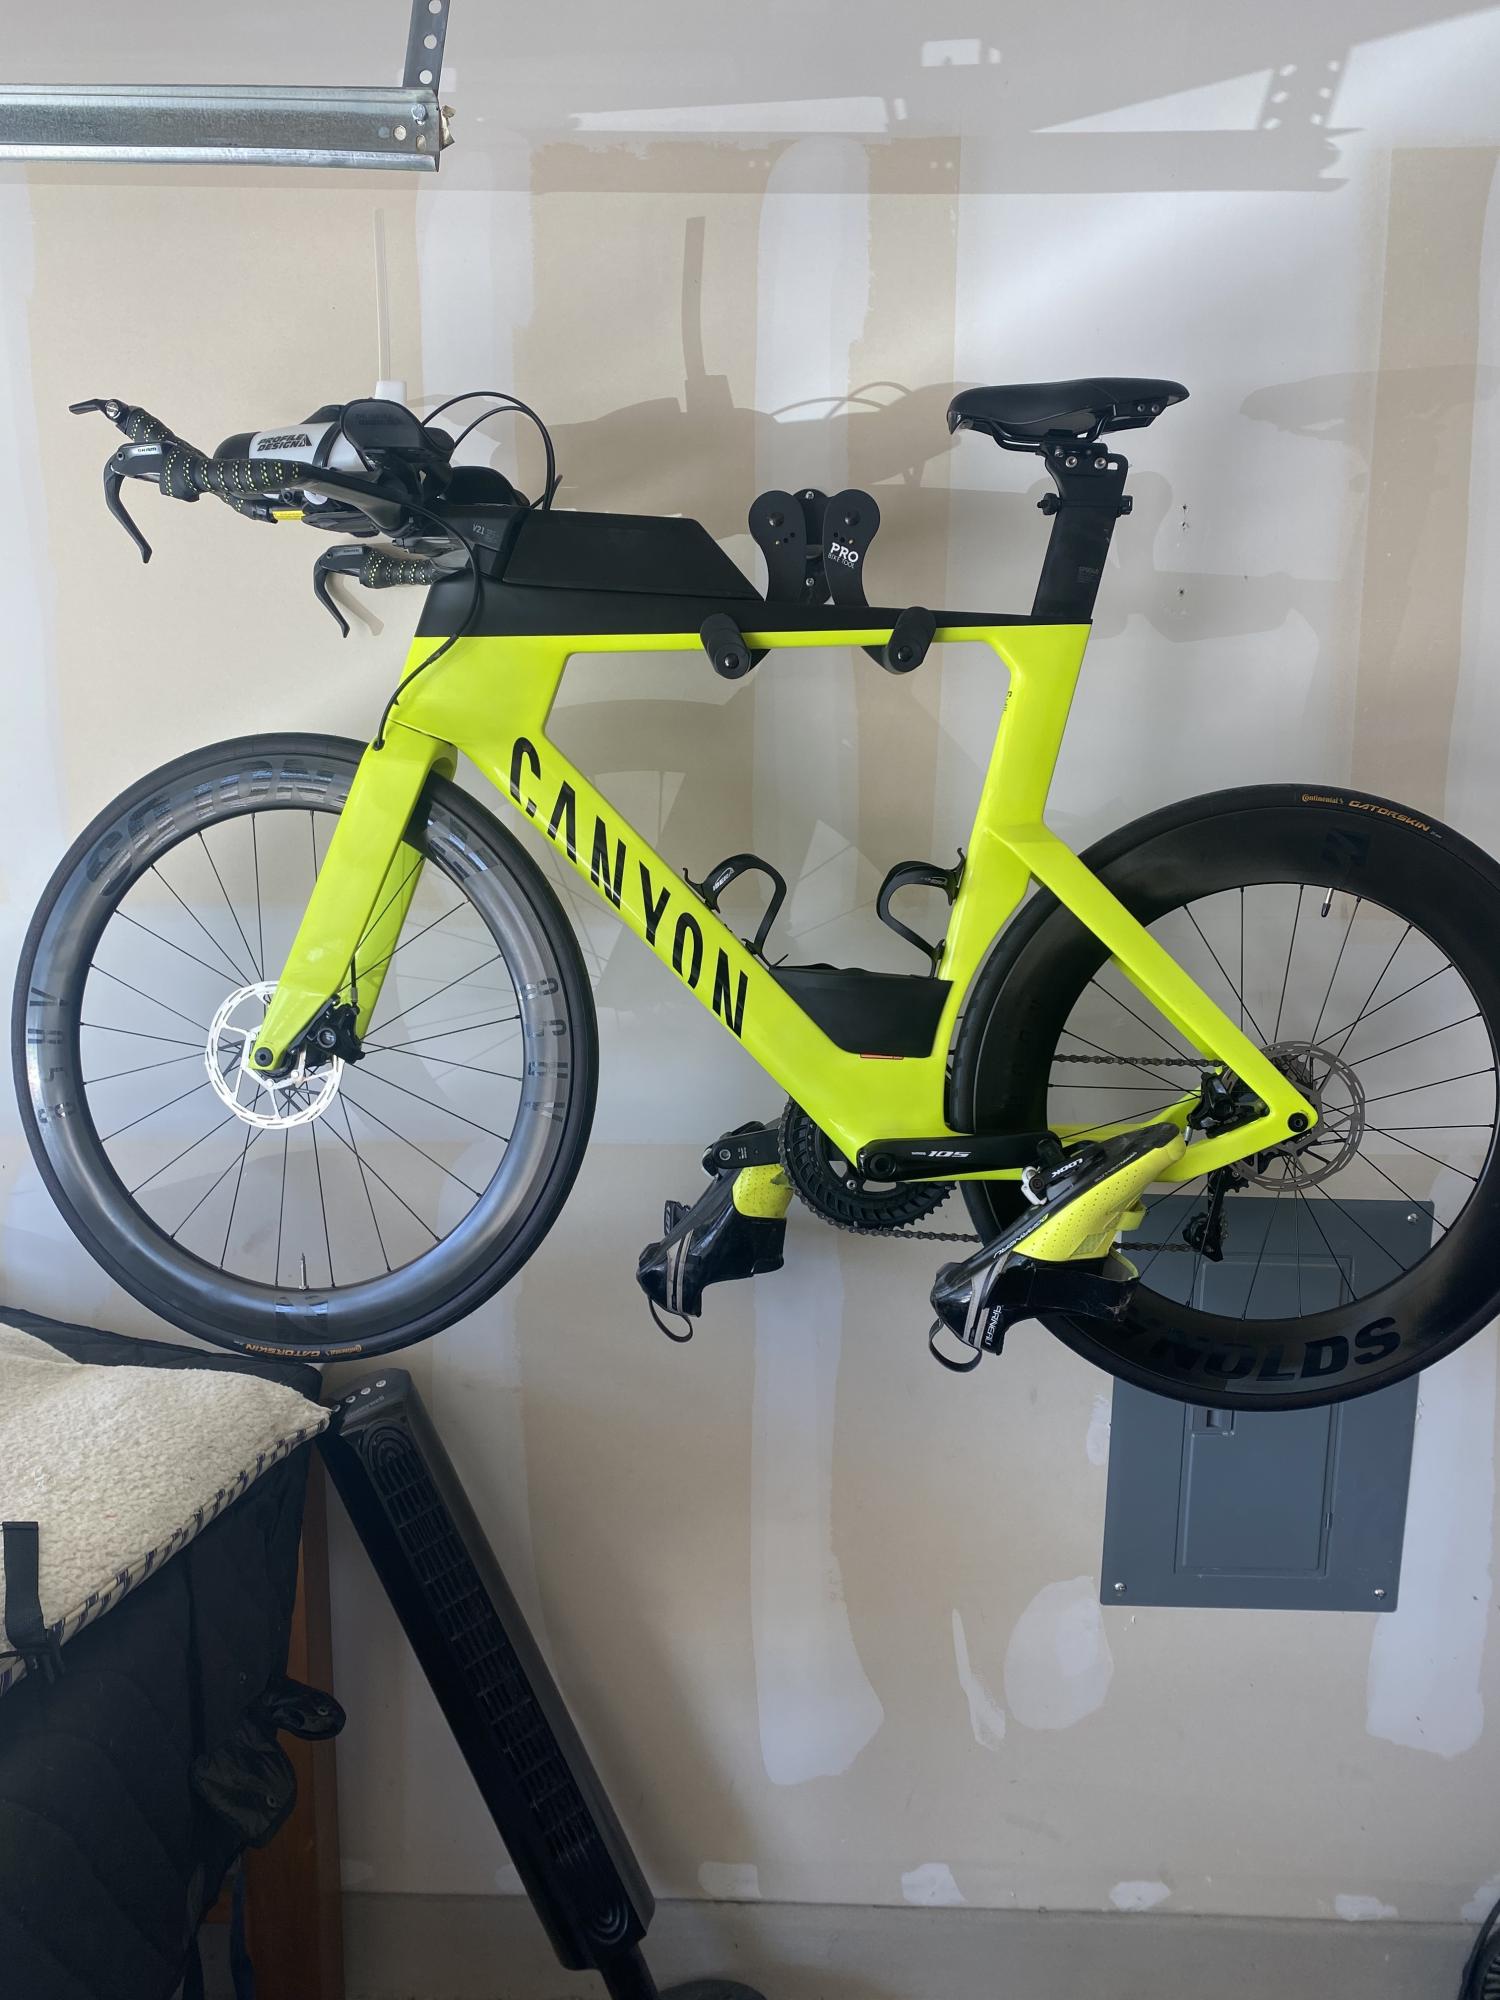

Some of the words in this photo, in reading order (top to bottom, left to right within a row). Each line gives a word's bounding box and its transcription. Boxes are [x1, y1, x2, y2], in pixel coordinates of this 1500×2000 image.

[257, 440, 302, 452] DESIGN
[258, 433, 306, 446] PROFILE
[830, 541, 859, 563] PRO
[1301, 793, 1339, 804] Continental
[1348, 800, 1431, 832] GATORSKIN
[509, 736, 749, 1040] CANYON
[928, 1150, 972, 1158] 105
[1050, 1157, 1084, 1178] LOOK
[245, 1343, 321, 1358] GATORSKIN
